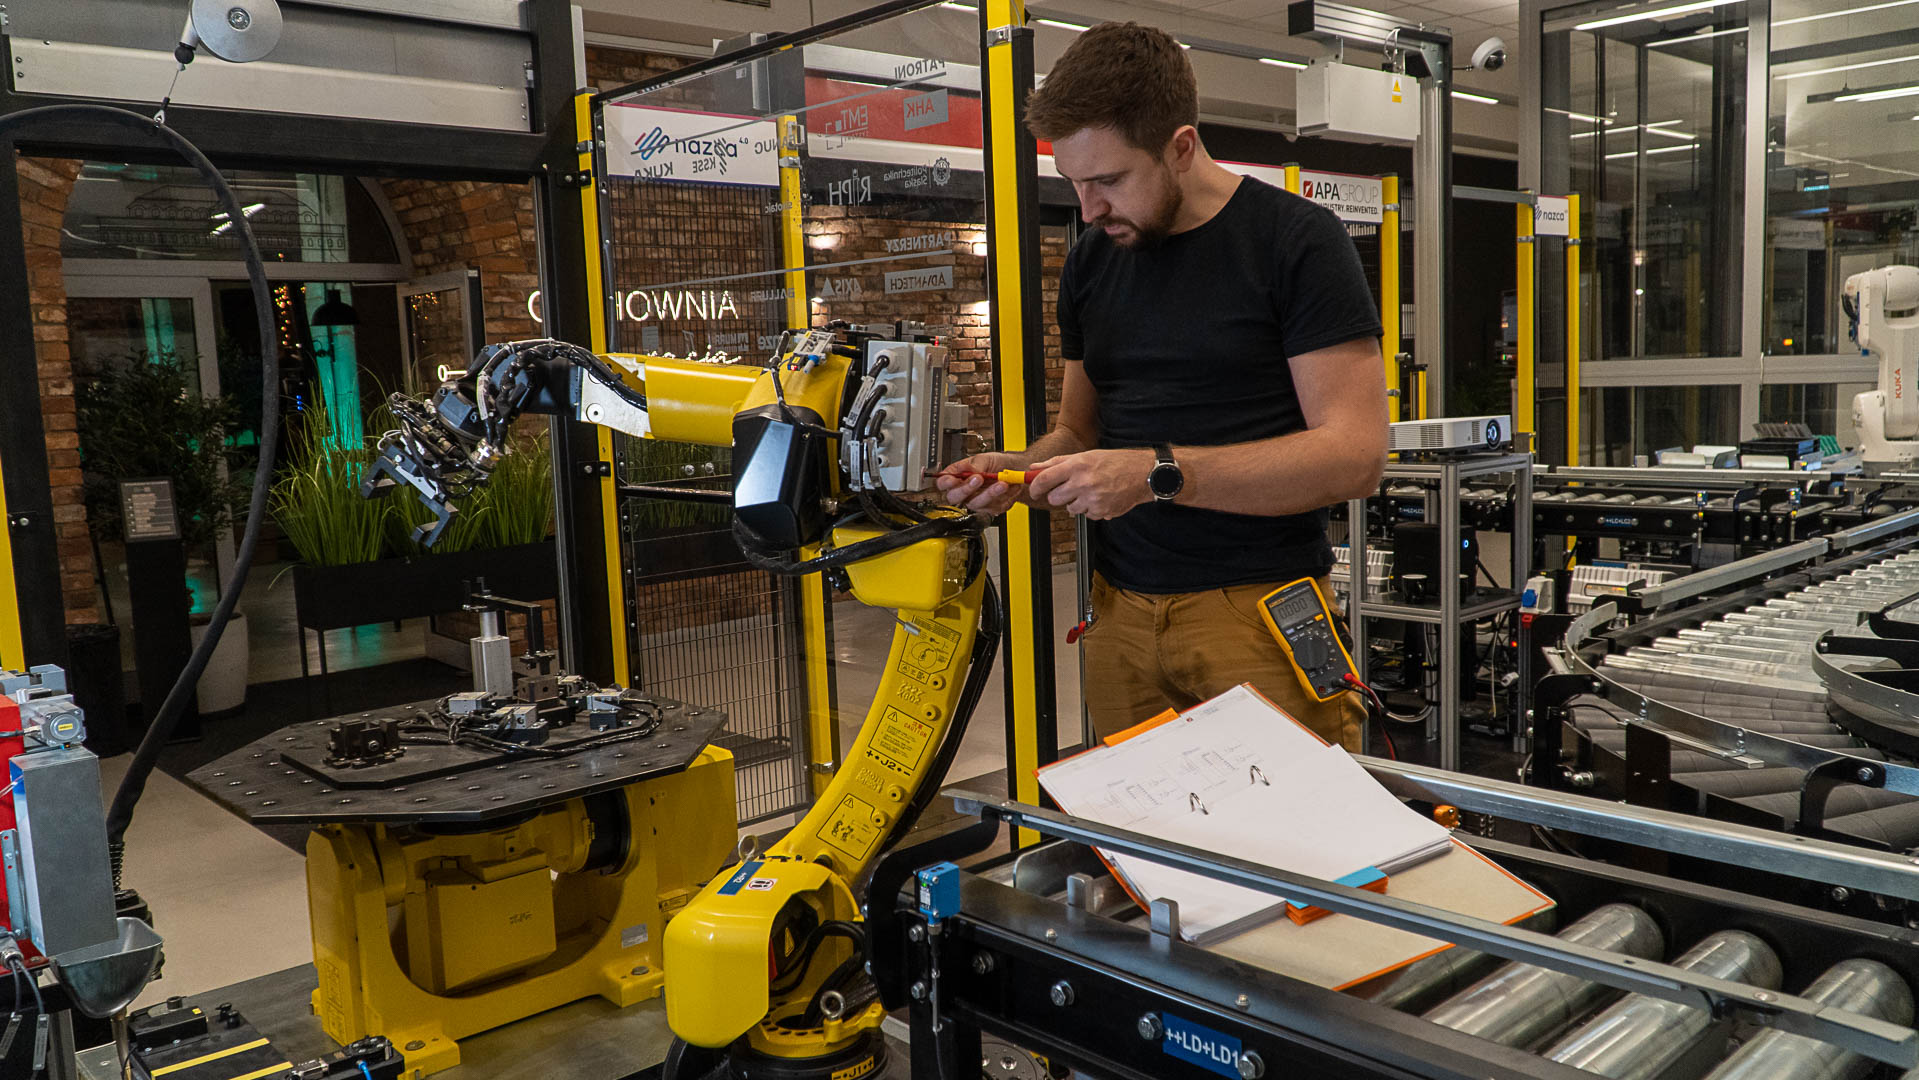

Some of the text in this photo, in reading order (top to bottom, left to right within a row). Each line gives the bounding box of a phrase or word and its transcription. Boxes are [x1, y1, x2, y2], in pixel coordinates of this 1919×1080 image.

[1543, 211, 1565, 222] nazca
[1894, 368, 1902, 399] KUKA
[903, 722, 928, 738] CAUTION
[1165, 1028, 1239, 1069] ++LD+LD1
